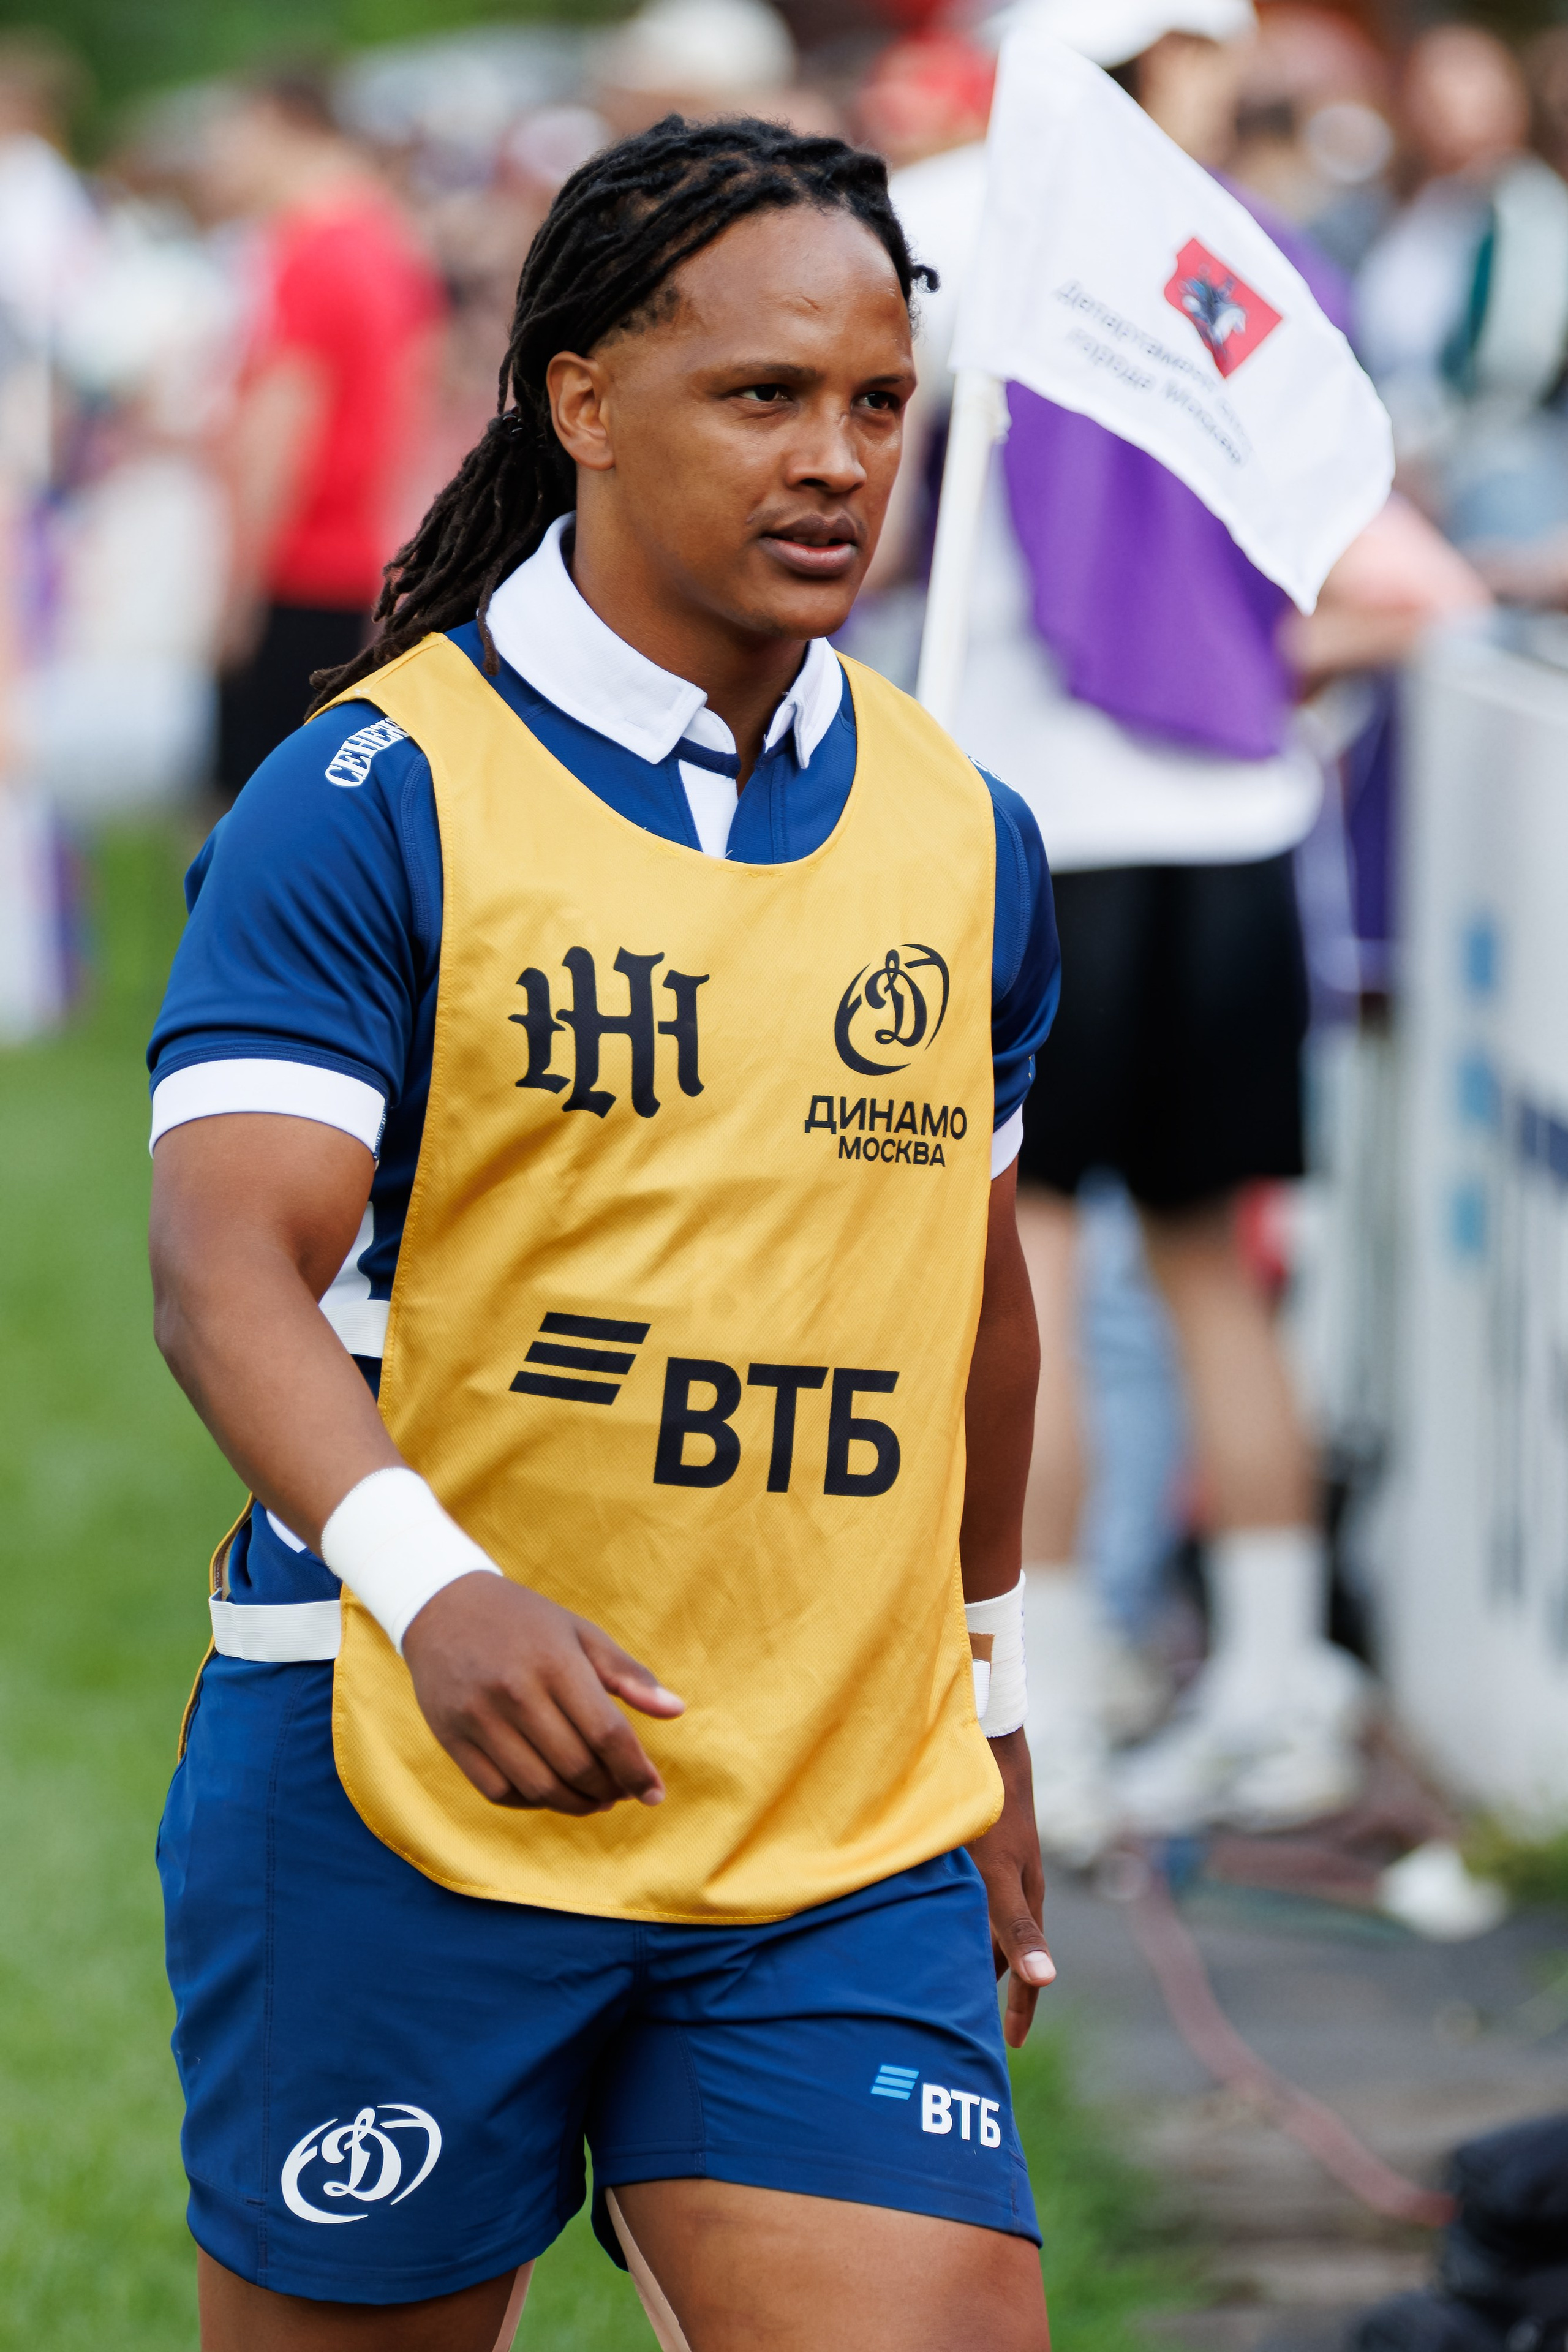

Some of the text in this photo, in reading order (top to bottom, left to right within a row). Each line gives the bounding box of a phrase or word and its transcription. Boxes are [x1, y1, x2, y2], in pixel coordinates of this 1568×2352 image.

[804, 1095, 967, 1140] ДИНАМО
[839, 1136, 946, 1167] МОСКВА
[653, 1357, 900, 1497] ВТБ
[922, 2082, 1001, 2149] ВТБ
